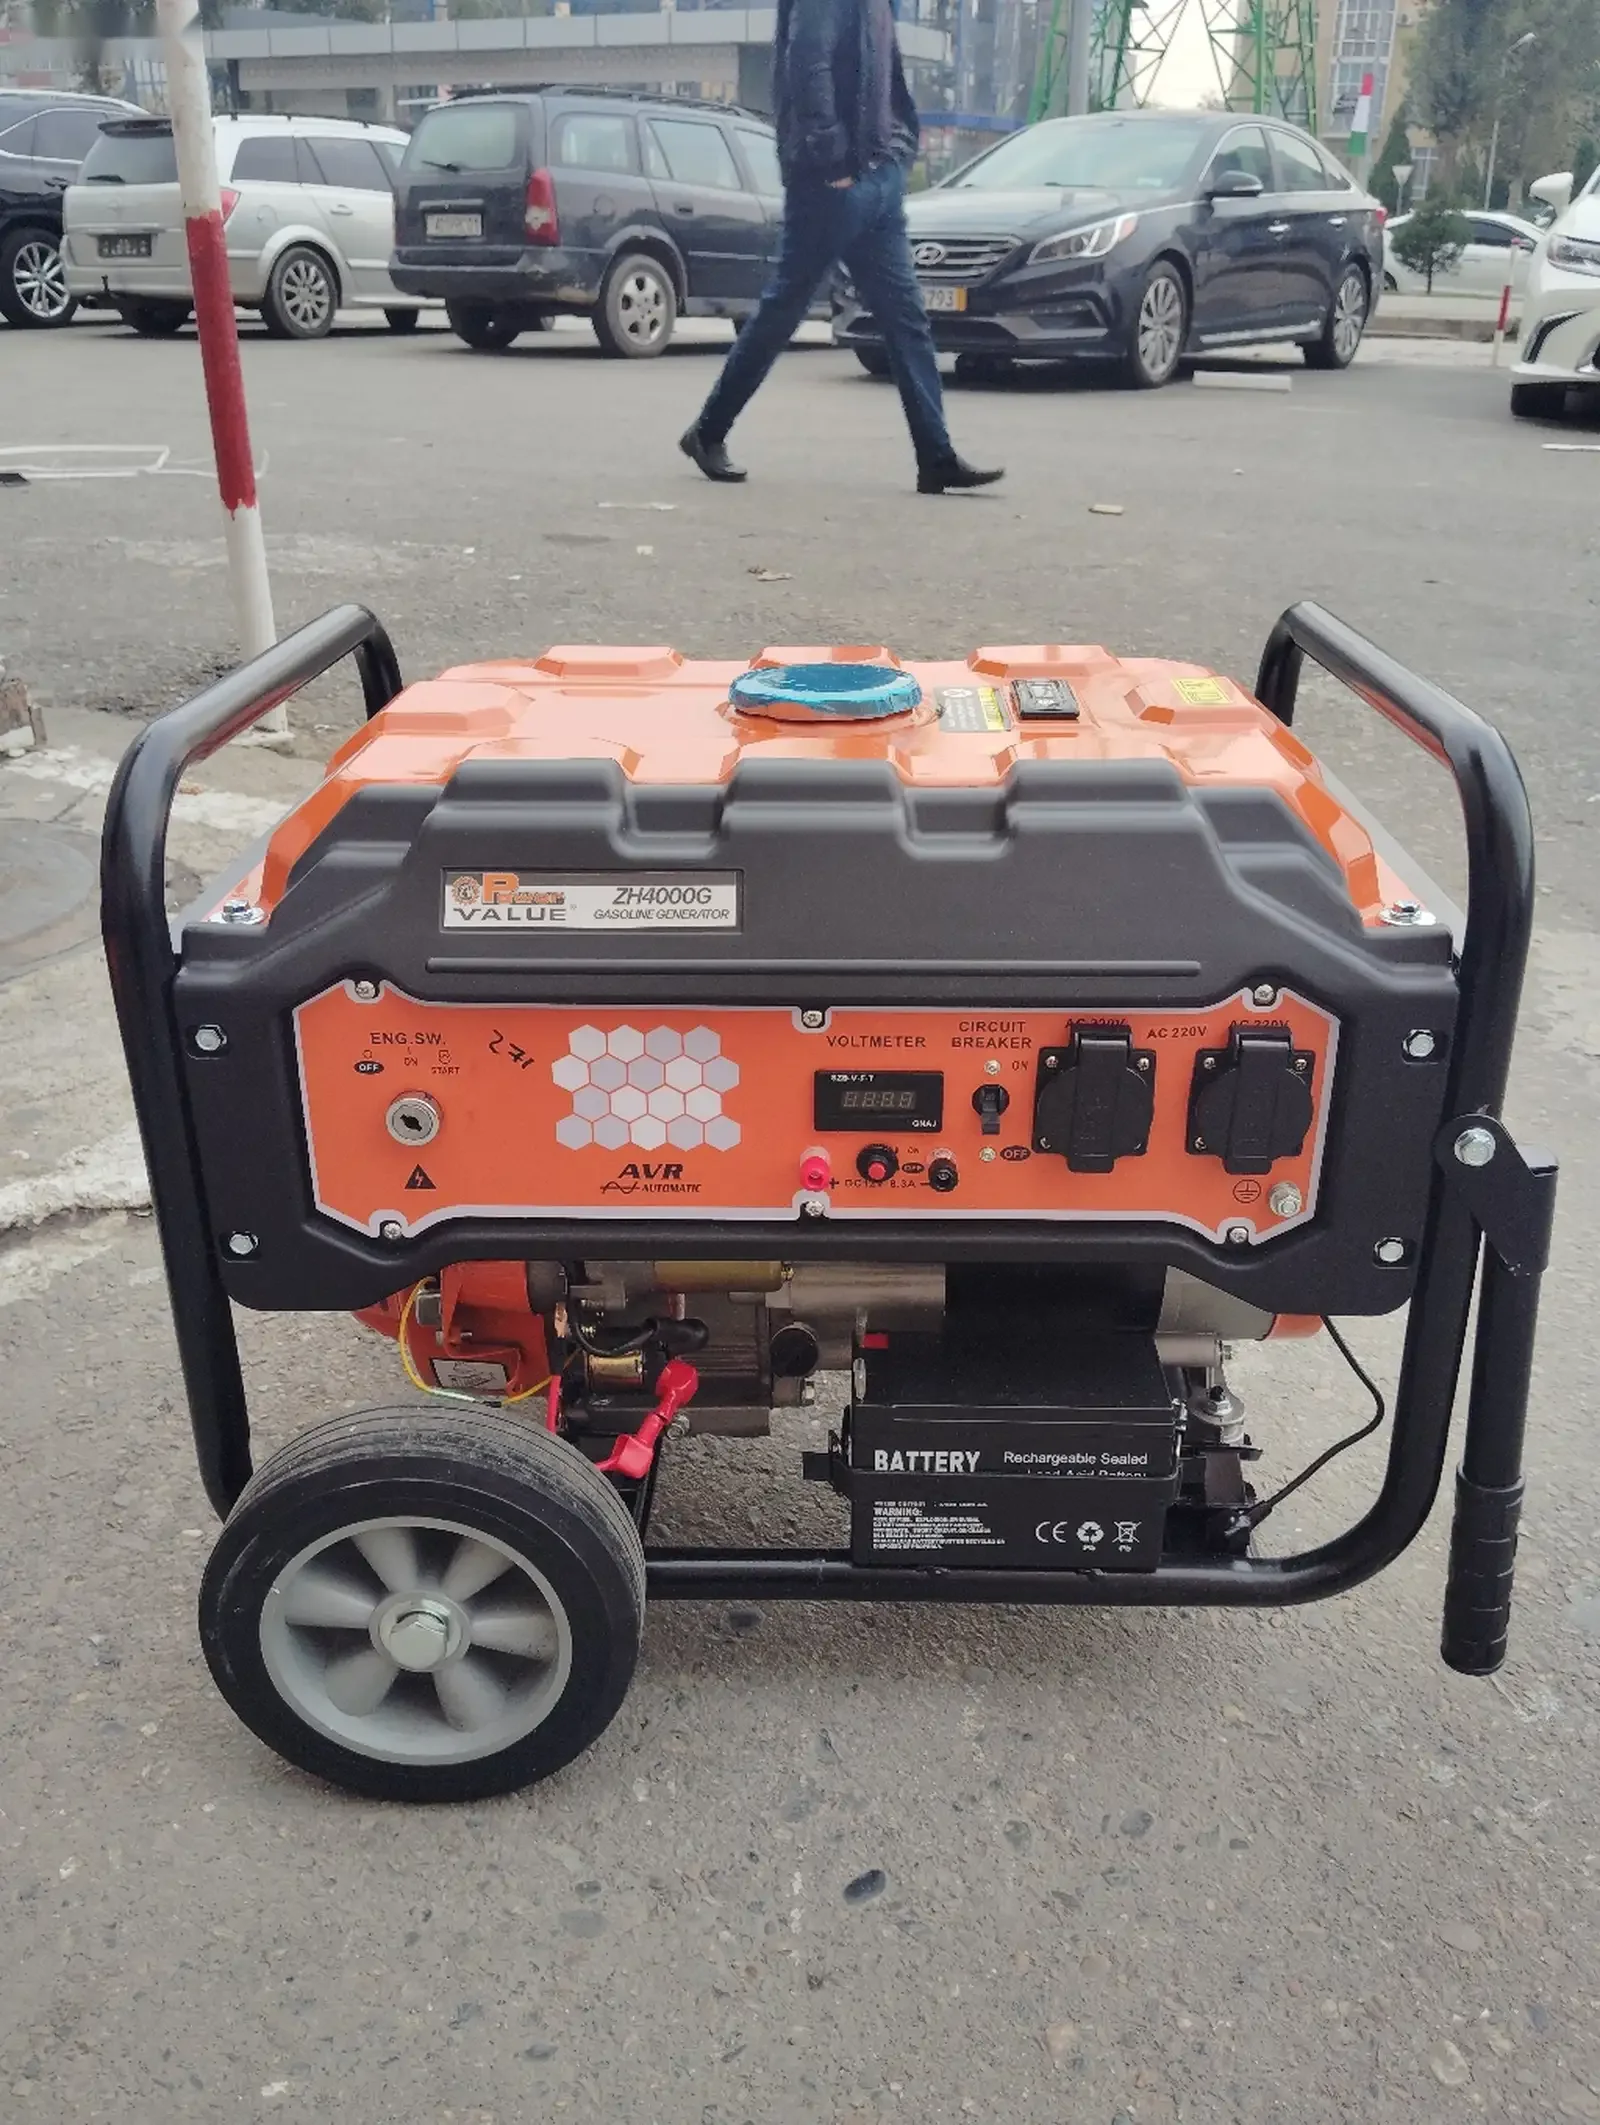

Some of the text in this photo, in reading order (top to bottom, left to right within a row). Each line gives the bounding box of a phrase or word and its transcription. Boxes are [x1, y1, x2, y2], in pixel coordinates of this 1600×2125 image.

[612, 887, 712, 905] ZH4000G
[453, 907, 566, 920] VALUE
[593, 909, 730, 920] GASOLINE GENERATOR
[959, 1021, 1027, 1033] CIRCUIT
[1147, 1025, 1208, 1039] AC 220V
[826, 1035, 926, 1048] VOLTMETER
[951, 1037, 1032, 1049] BREAKER
[358, 1063, 379, 1073] OFF
[431, 1066, 461, 1076] START
[1012, 1060, 1029, 1071] ON
[1003, 1149, 1027, 1160] OFF
[618, 1164, 683, 1179] AVR
[641, 1183, 702, 1193] AUTOMATIC
[874, 1449, 981, 1473] BATTERY
[1003, 1450, 1148, 1466] Rechargeable Sealed
